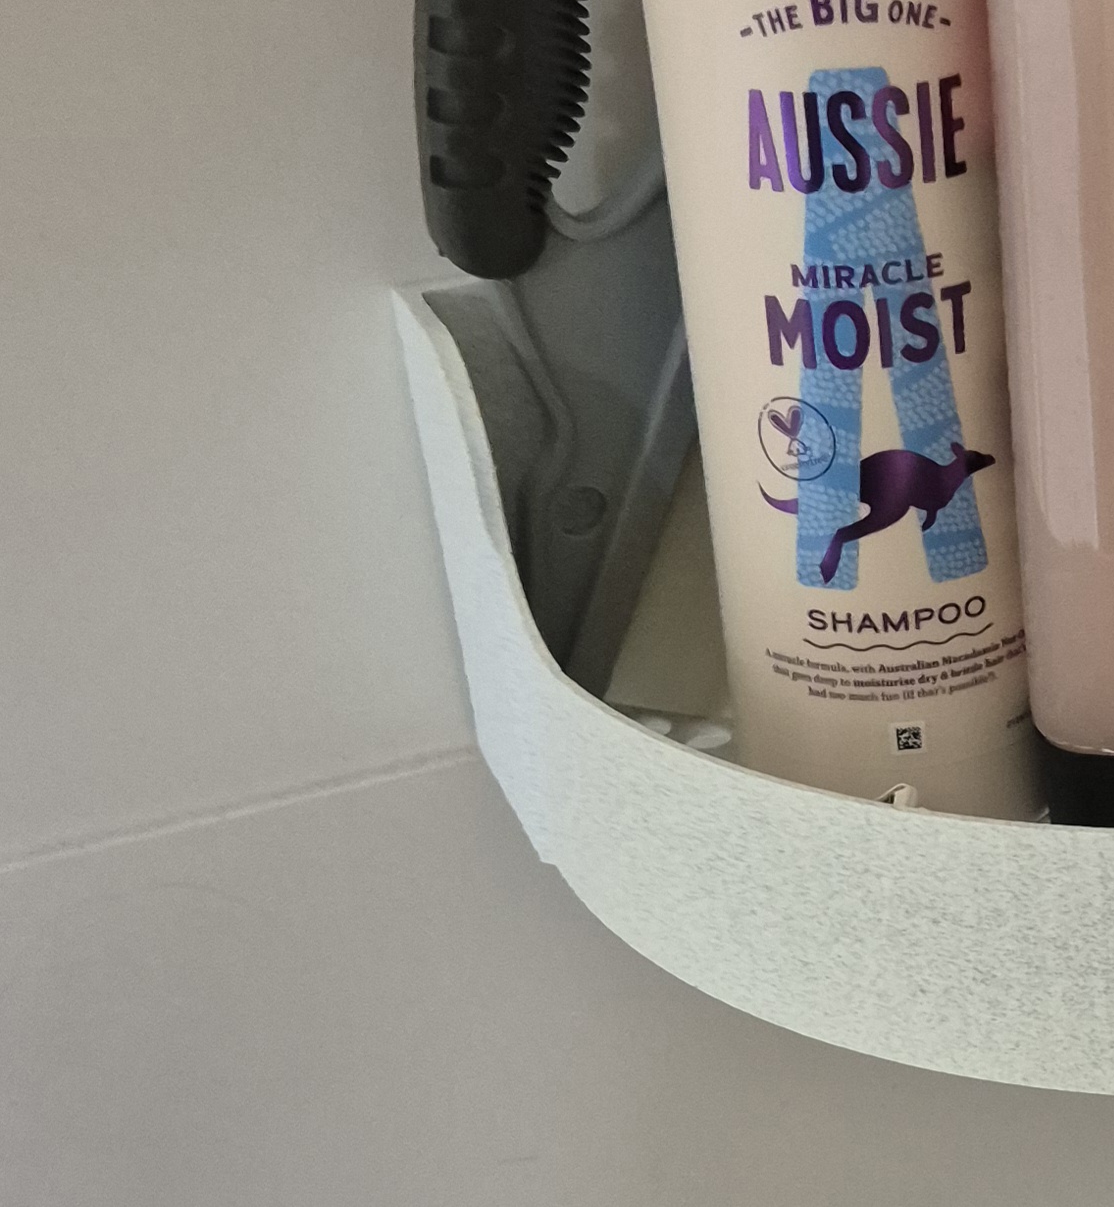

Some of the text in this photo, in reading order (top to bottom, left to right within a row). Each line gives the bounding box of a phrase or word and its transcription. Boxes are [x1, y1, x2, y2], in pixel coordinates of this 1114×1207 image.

[747, 73, 968, 195] AUSSIE
[790, 252, 944, 290] MIRACLE
[764, 280, 972, 371] MOIST
[806, 595, 987, 634] SHAMPOO
[840, 678, 851, 688] to
[853, 676, 916, 689] moisturise
[918, 673, 938, 686] dry
[878, 659, 939, 674] Australian
